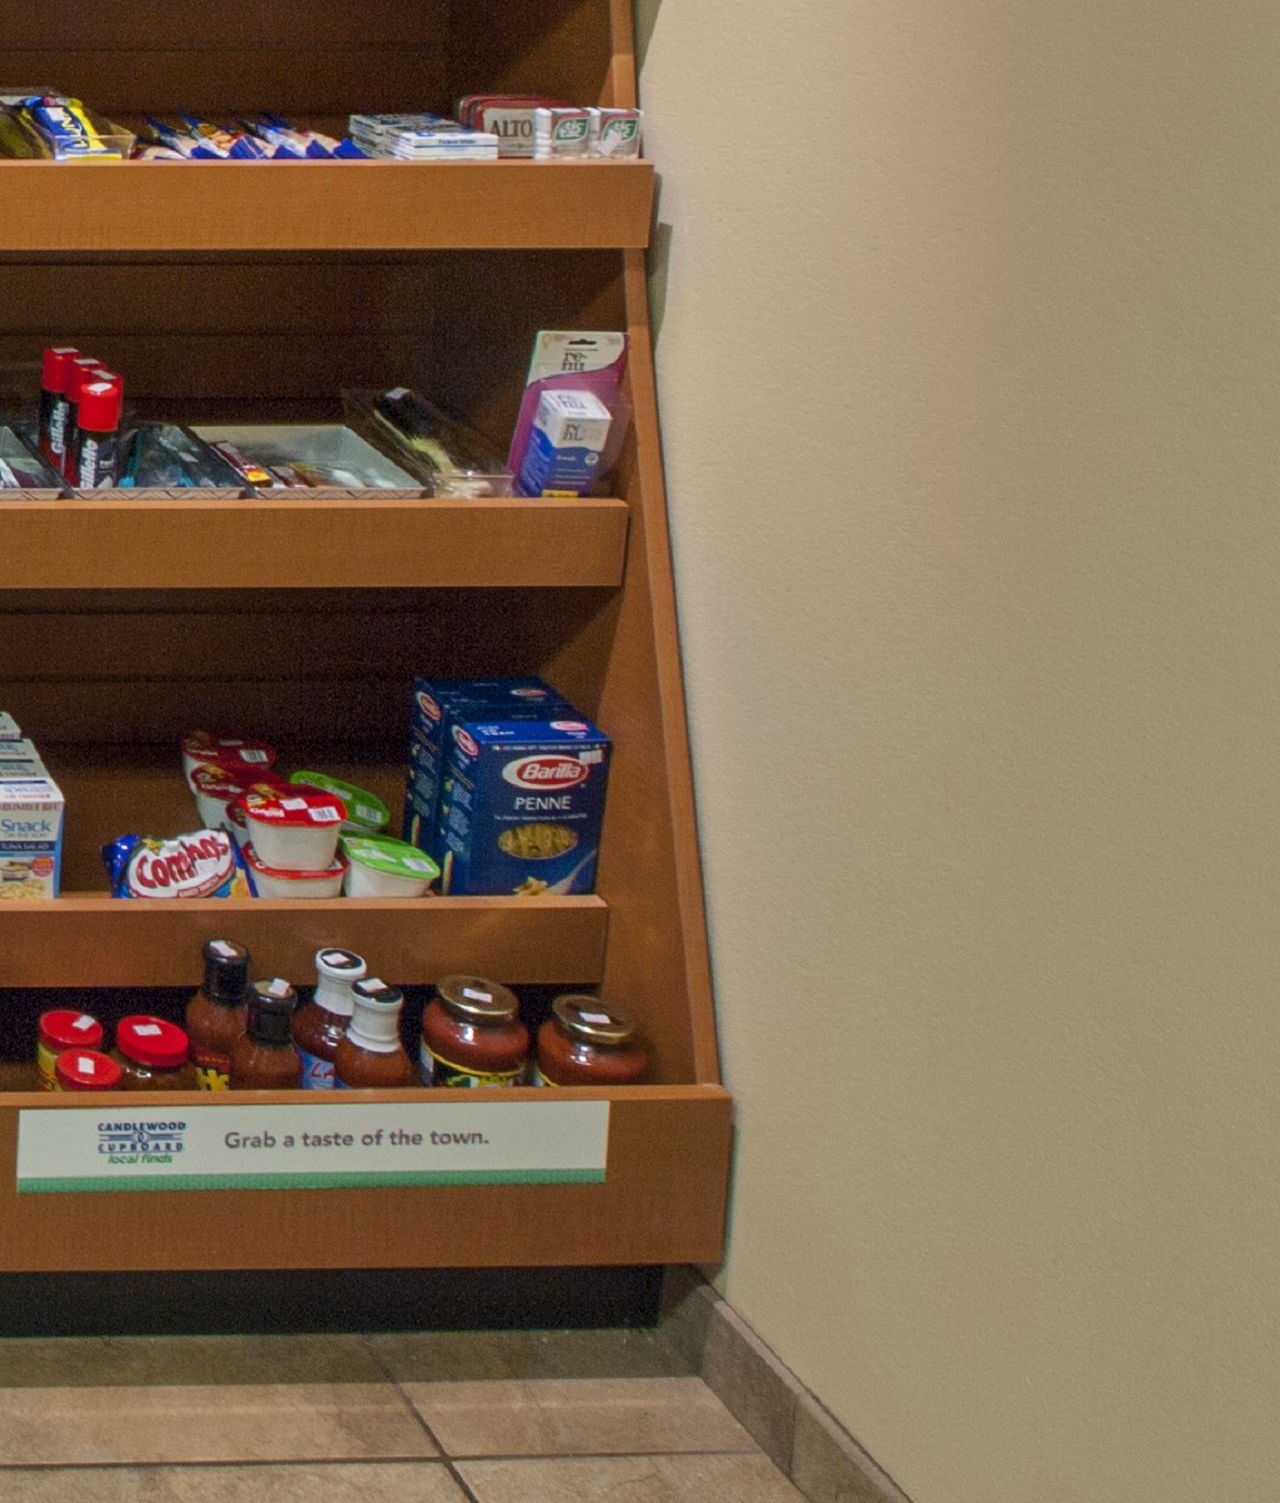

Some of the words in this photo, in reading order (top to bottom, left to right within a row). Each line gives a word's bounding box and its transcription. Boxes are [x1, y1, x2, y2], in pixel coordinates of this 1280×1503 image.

[492, 119, 533, 137] ALTO
[565, 120, 584, 131] tic
[522, 762, 582, 780] Barilla
[513, 795, 572, 811] PENNE
[0, 818, 52, 833] Snack
[135, 834, 230, 890] Combos
[97, 1121, 187, 1132] CANDLEWOOD
[224, 1130, 277, 1150] Grab
[283, 1135, 295, 1148] a
[300, 1130, 354, 1148] taste
[360, 1129, 384, 1147] of
[389, 1128, 423, 1147] the
[429, 1129, 490, 1147] town.
[97, 1142, 184, 1153] CUPBOARD
[107, 1153, 138, 1165] local
[140, 1153, 174, 1165] finds
